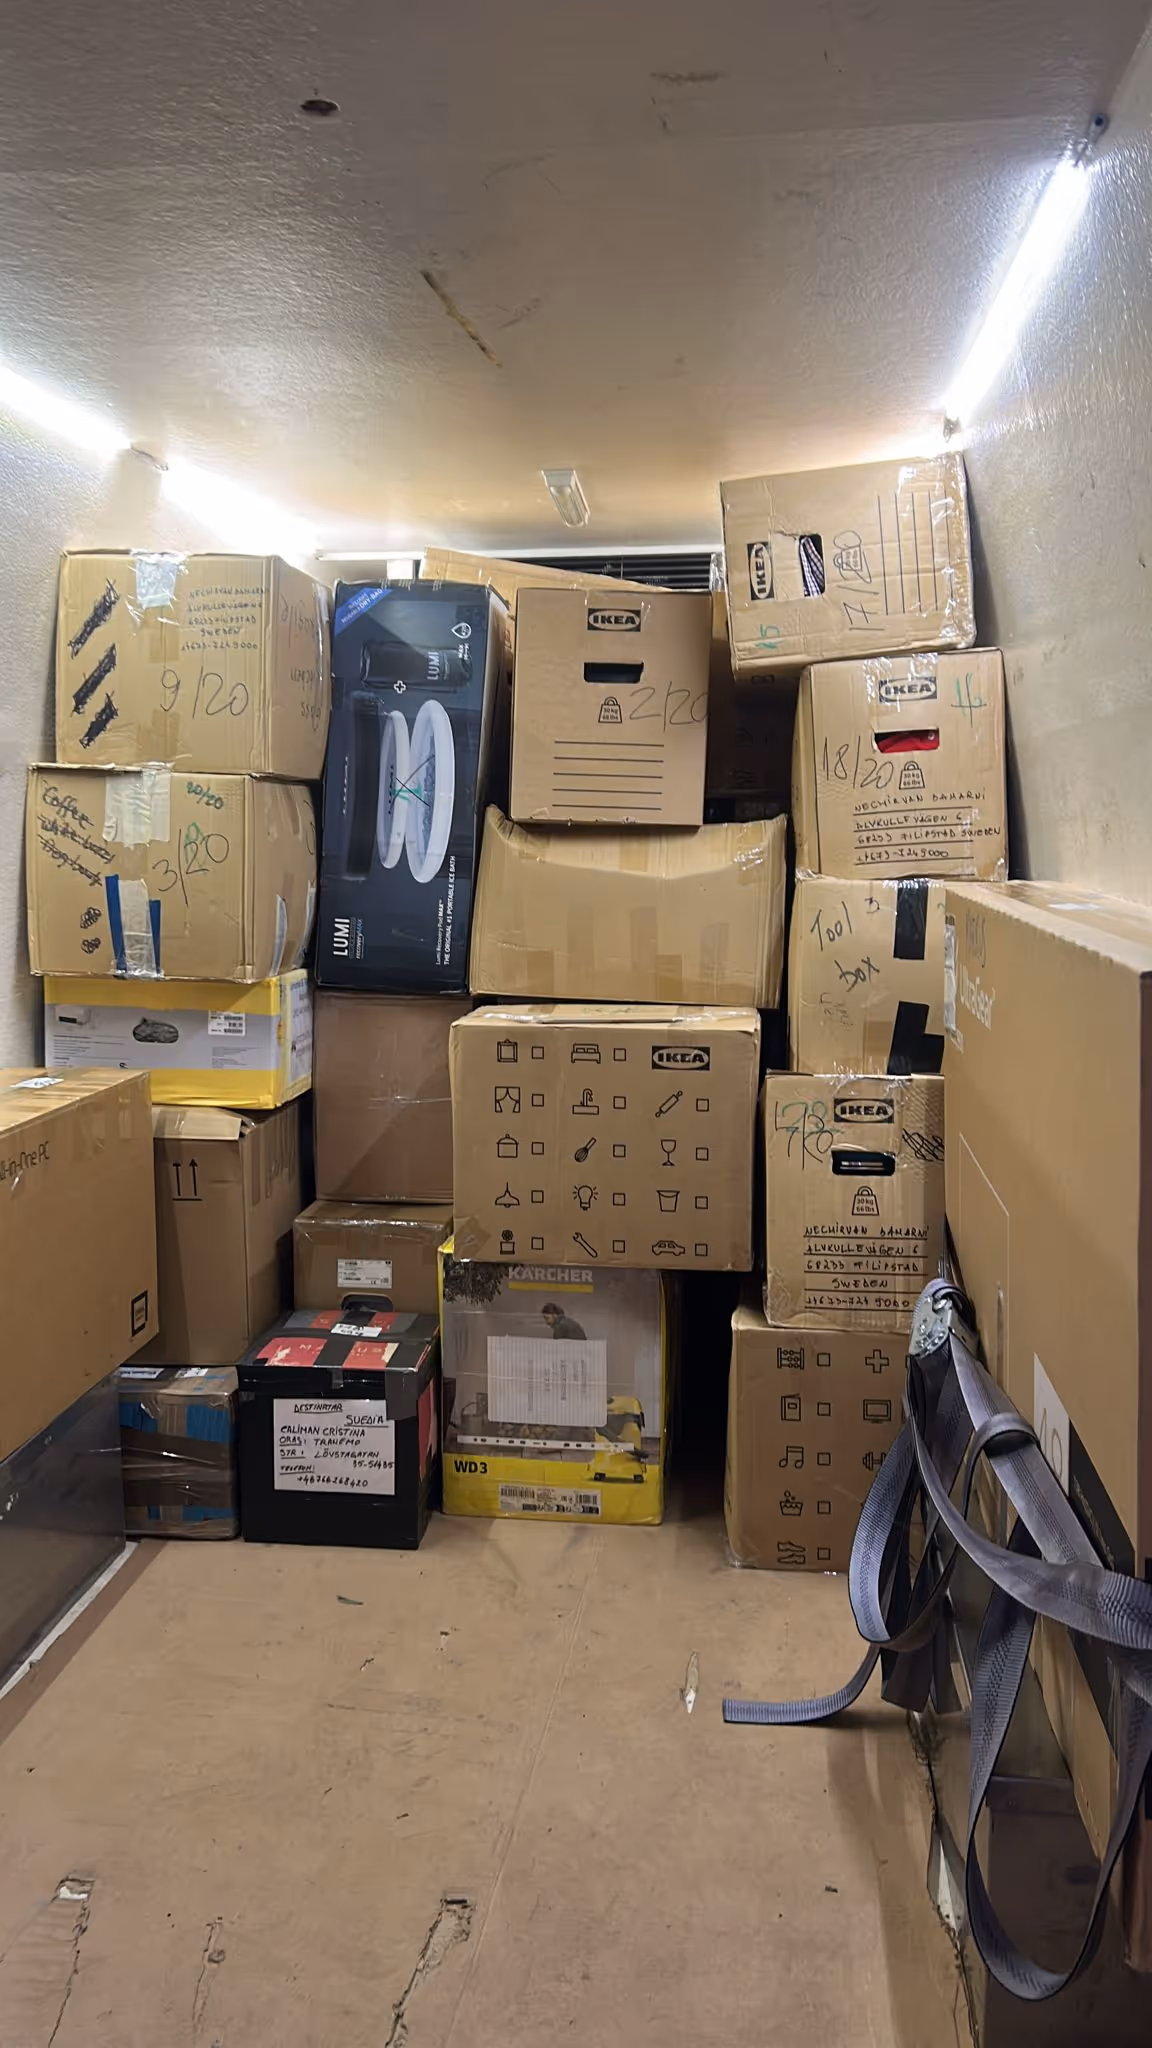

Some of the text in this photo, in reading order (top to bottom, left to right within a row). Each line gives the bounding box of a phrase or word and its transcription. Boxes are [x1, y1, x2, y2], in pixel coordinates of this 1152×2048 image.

[754, 545, 768, 594] IKEA
[591, 614, 638, 626] IKEA
[426, 651, 440, 681] LUMI
[159, 666, 250, 720] 9/20
[883, 683, 932, 696] IKEA
[629, 680, 709, 734] 2/20
[822, 735, 894, 789] 18/20
[152, 828, 230, 907] 3/20
[446, 884, 455, 915] PORTABLE
[333, 918, 350, 957] LUMI
[810, 900, 853, 952] Tool
[436, 928, 444, 951] Recovery
[444, 925, 452, 953] ORIGINAL
[833, 956, 880, 993] box
[657, 1051, 705, 1064] IKEA
[839, 1105, 889, 1116] IKEA
[865, 1198, 874, 1206] kg
[831, 1277, 888, 1289] SWEDEN
[293, 1403, 343, 1414] DESTINATAR
[346, 1414, 384, 1426] SUEDIA
[280, 1424, 366, 1437] CALIMAN CRISTINA
[313, 1438, 361, 1446] TRANEMO
